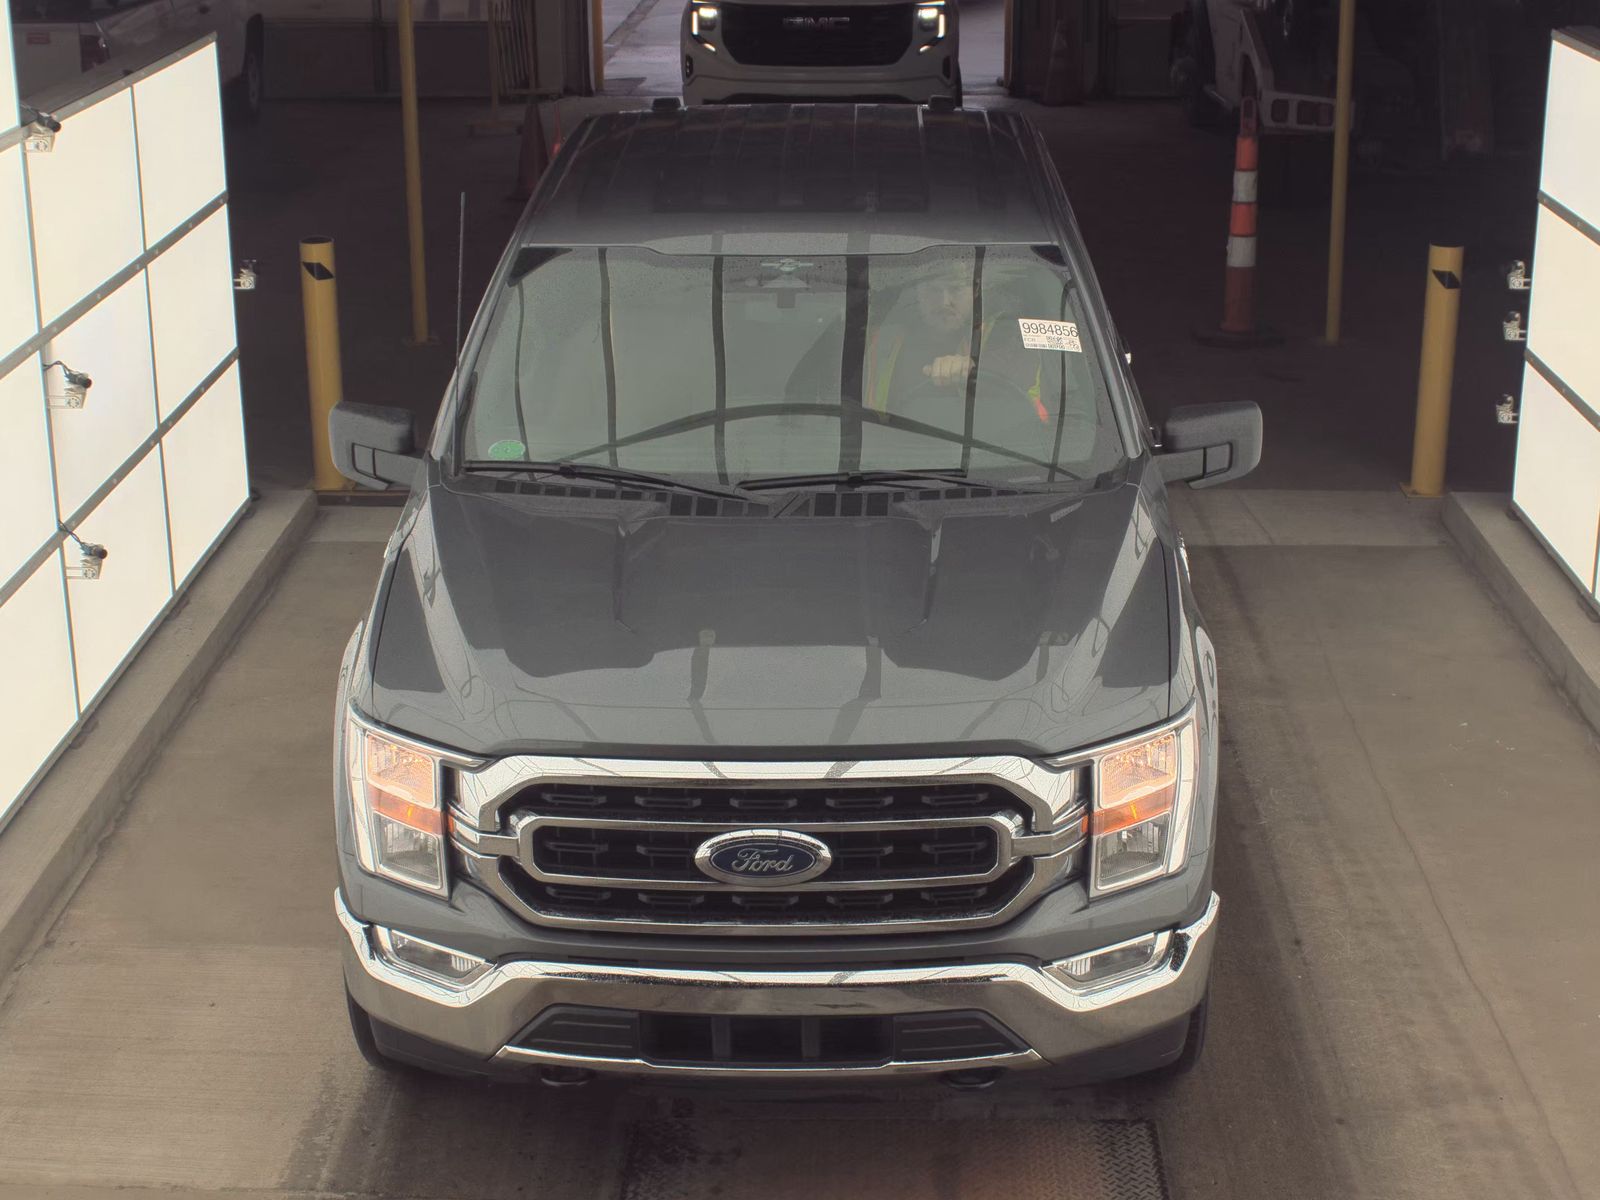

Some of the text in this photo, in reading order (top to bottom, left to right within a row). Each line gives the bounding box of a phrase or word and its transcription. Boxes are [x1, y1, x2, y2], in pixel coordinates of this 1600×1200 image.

[782, 16, 850, 30] GMC
[1022, 322, 1079, 338] 9984856
[731, 847, 795, 872] Ford
